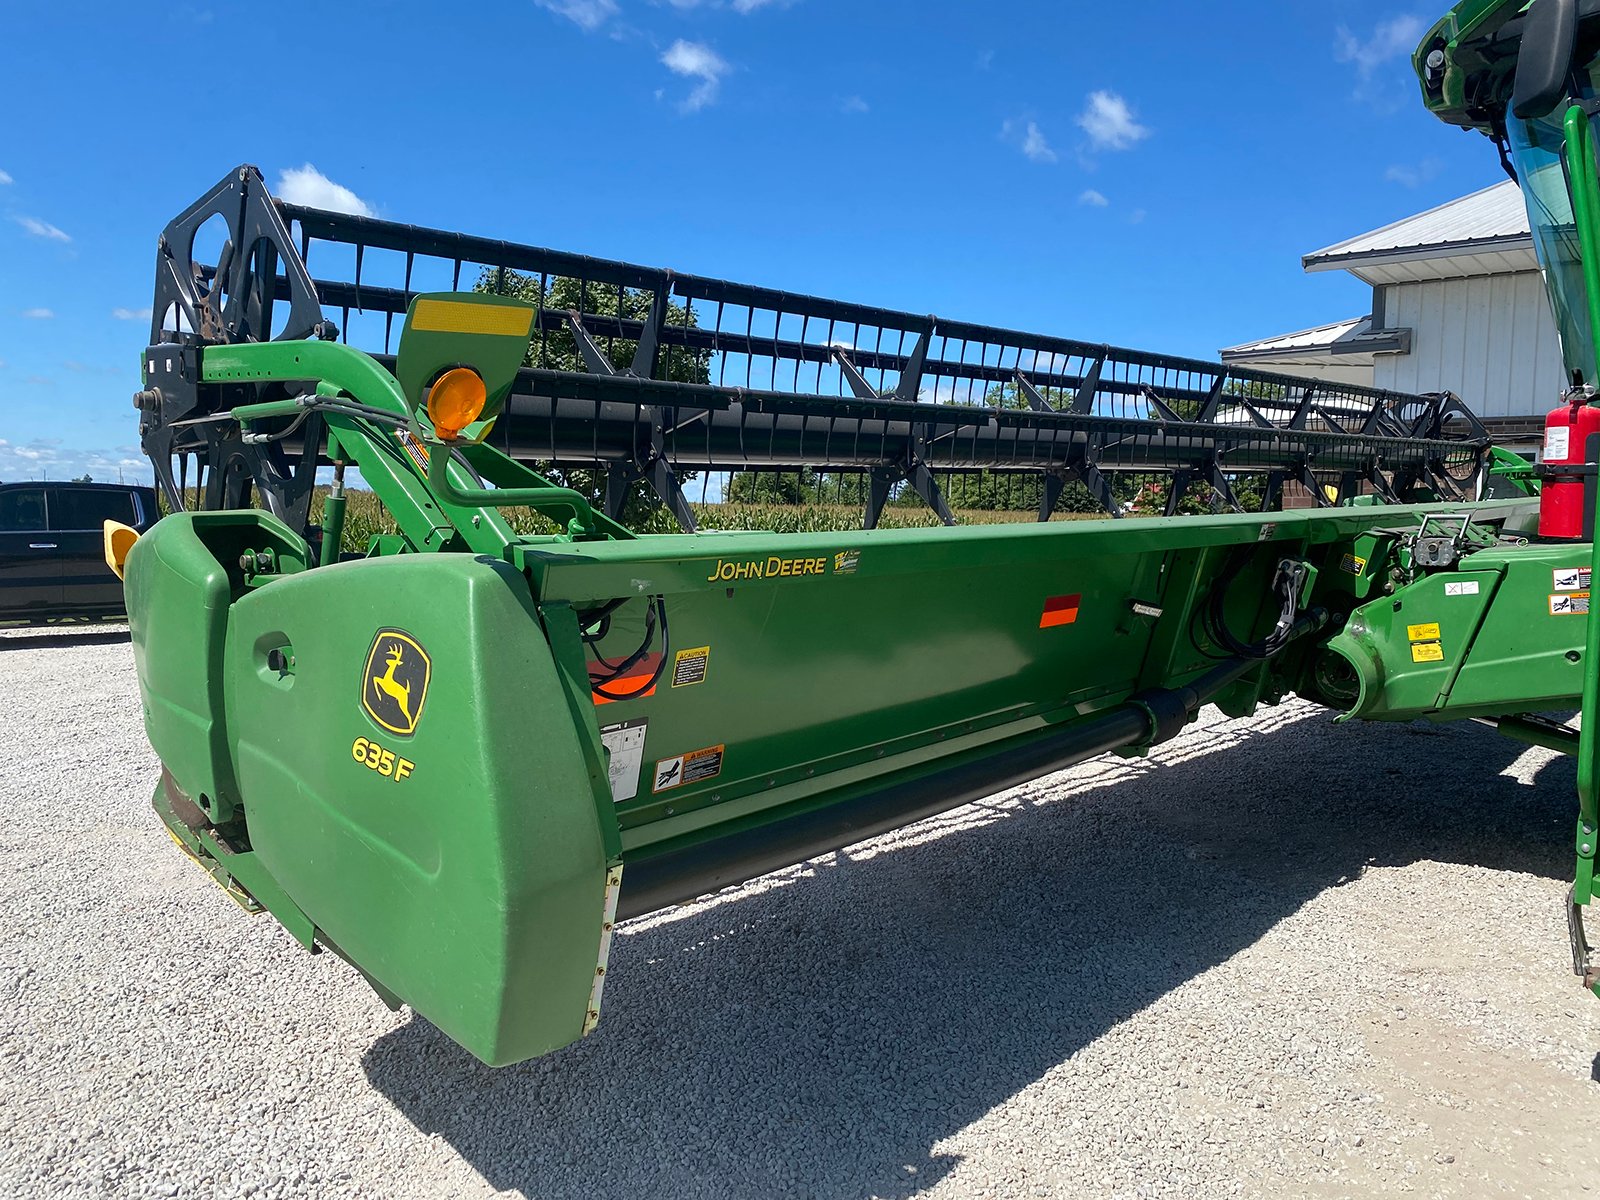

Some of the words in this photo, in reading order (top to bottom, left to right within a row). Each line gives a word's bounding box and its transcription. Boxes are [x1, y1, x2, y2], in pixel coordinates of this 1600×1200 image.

[707, 559, 764, 582] JOHN
[765, 556, 827, 578] DEERE
[352, 736, 416, 782] 635F
